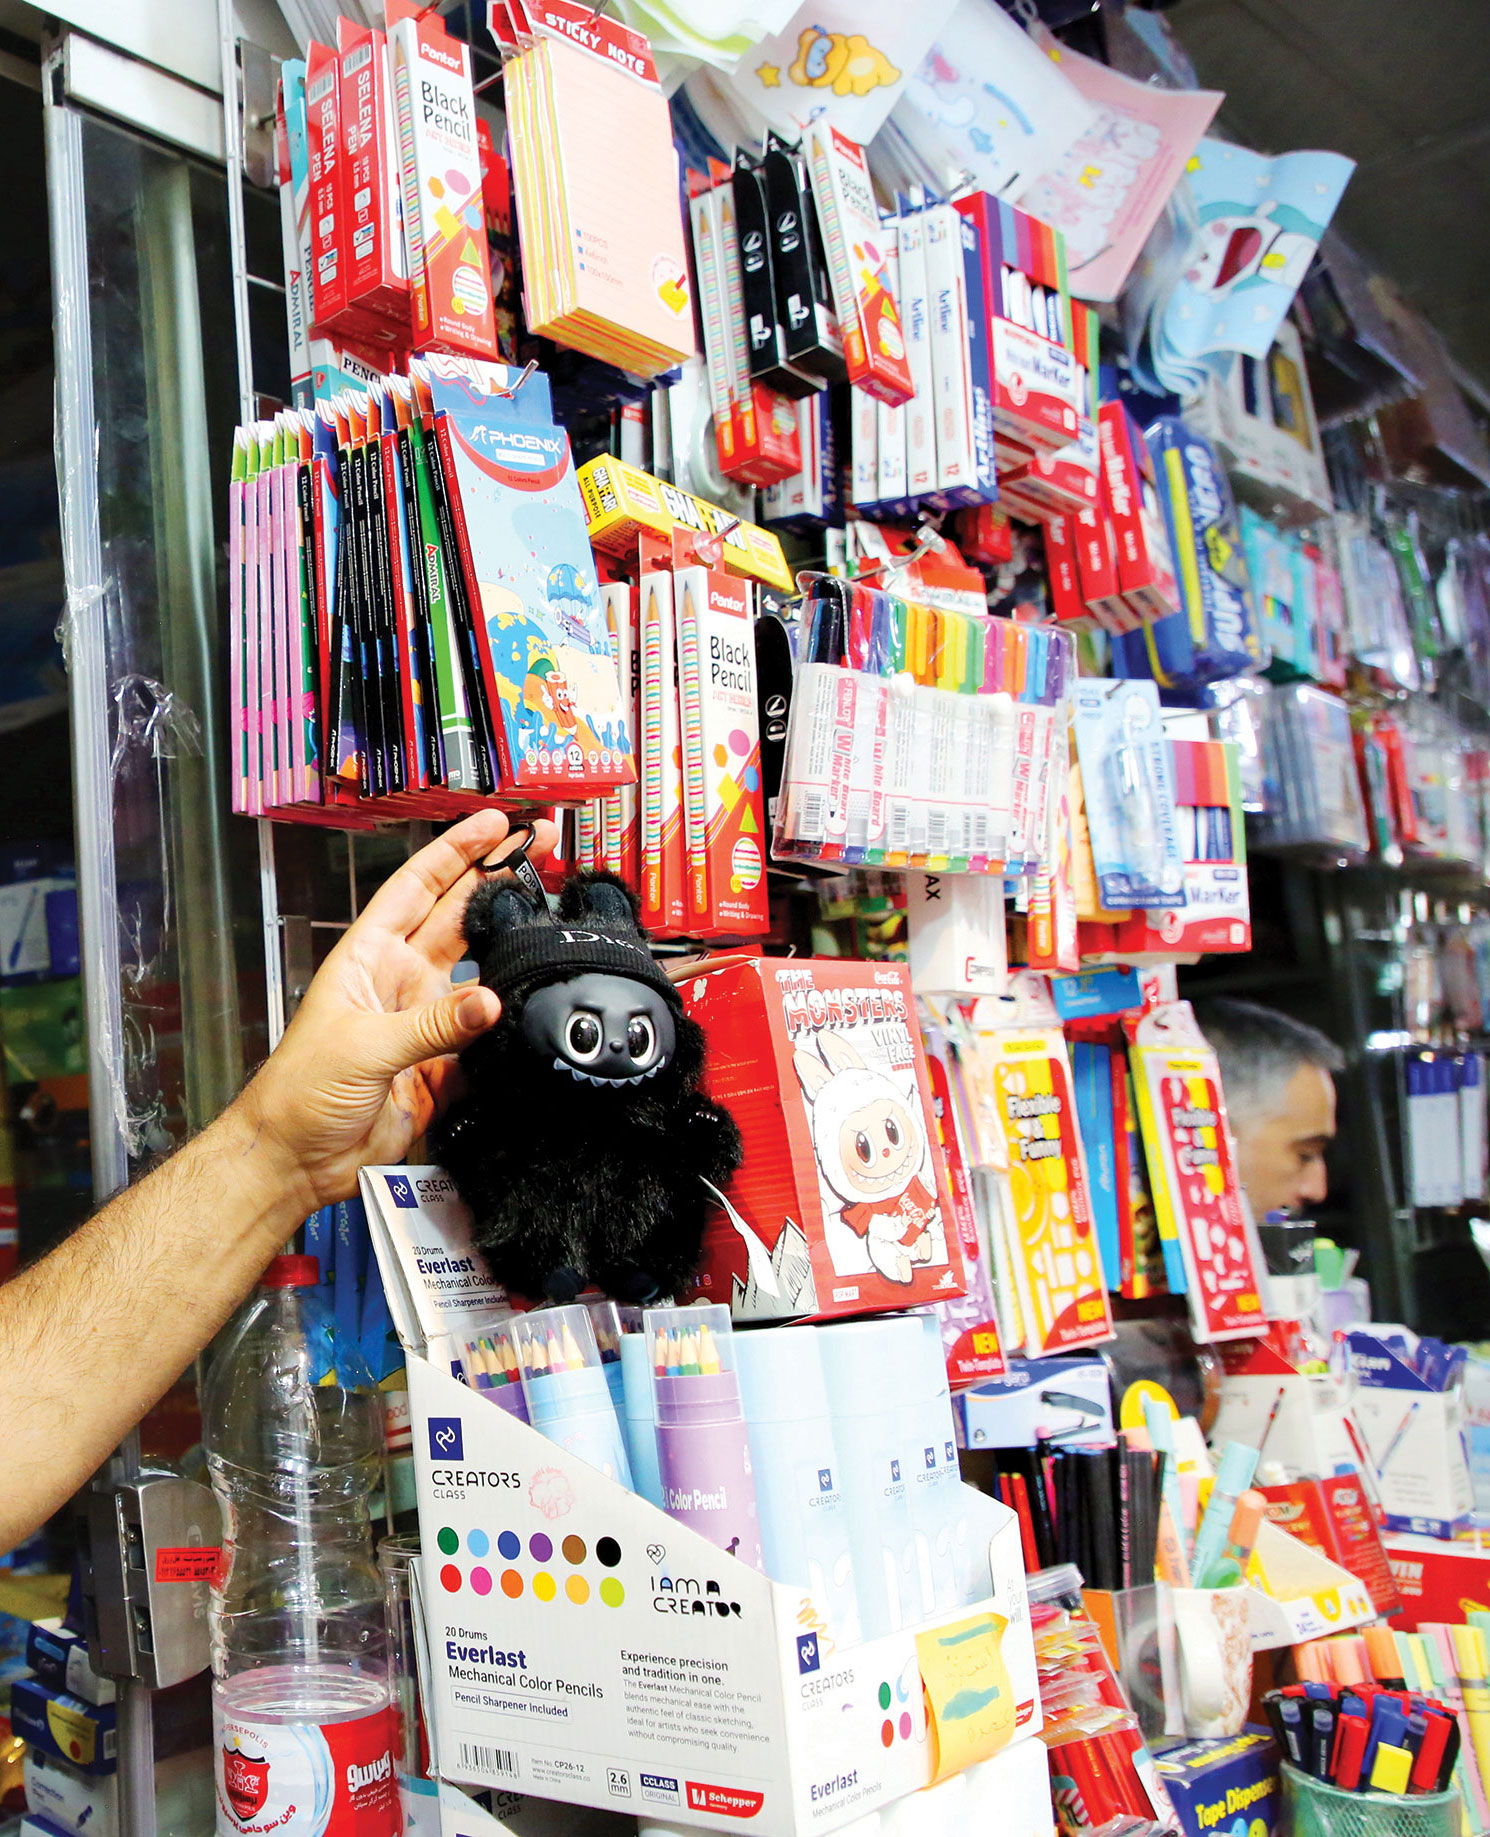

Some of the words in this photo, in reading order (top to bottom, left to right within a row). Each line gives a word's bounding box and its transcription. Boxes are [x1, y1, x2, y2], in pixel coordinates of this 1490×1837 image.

[545, 12, 601, 49] STICKY
[608, 42, 645, 75] NOTE
[420, 42, 461, 70] Panter
[357, 69, 372, 148] SELENA
[421, 80, 469, 120] Black
[423, 104, 471, 142] Pencil
[321, 98, 336, 174] SELENA
[347, 127, 357, 156] PEN
[311, 153, 321, 182] PEN
[289, 270, 302, 352] ADMIRAL
[401, 440, 407, 450] 12
[428, 442, 433, 451] 12
[488, 430, 561, 454] PHOENIX
[973, 386, 990, 488] Artline
[340, 462, 346, 471] 12
[355, 458, 361, 468] 12
[370, 452, 377, 462] 12
[302, 476, 307, 484] 12
[586, 488, 602, 519] PURPOSE
[425, 543, 442, 604] ADMIRAL
[710, 592, 744, 613] Panter
[710, 635, 750, 669] Black
[711, 663, 752, 693] Pencil
[570, 750, 580, 761] 12
[830, 753, 842, 800] Marker
[871, 789, 883, 827] Board
[518, 865, 537, 889] POP
[723, 901, 737, 910] Round
[738, 902, 750, 911] Body
[723, 910, 740, 919] Writing
[745, 913, 764, 921] Drawing
[775, 969, 815, 993] THE
[783, 988, 909, 1041] MONSTERS
[871, 1027, 912, 1047] VINYL
[888, 1045, 915, 1064] FACE
[421, 1194, 445, 1203] CLASS
[412, 1247, 421, 1255] 20
[421, 1246, 445, 1255] Drums
[416, 1257, 476, 1275] Everlast
[423, 1277, 472, 1290] Mechanical
[472, 1275, 497, 1287] Colo
[434, 1299, 453, 1309] Pencil
[453, 1297, 484, 1309] Sharpener
[431, 1469, 521, 1489] CREATORS
[433, 1489, 466, 1500] CLASS
[669, 1487, 692, 1511] Color
[693, 1486, 728, 1511] Pencil
[651, 1576, 655, 1591] I
[660, 1577, 700, 1595] AM
[706, 1580, 721, 1596] A
[653, 1596, 742, 1619] CREATOR
[445, 1626, 457, 1637] 20
[458, 1628, 488, 1640] Drums
[446, 1641, 527, 1669] Everlast
[620, 1650, 677, 1666] Experience
[679, 1658, 729, 1671] precision
[449, 1665, 516, 1687] Mechanical
[519, 1675, 552, 1692] Color
[556, 1679, 604, 1698] Pencils
[622, 1666, 641, 1676] and
[643, 1667, 686, 1682] tradition
[689, 1672, 699, 1683] in
[701, 1675, 725, 1686] one.
[800, 1669, 855, 1699] CREATORS
[624, 1679, 637, 1688] The
[638, 1681, 668, 1692] Everlast
[669, 1684, 712, 1697] Mechanical
[714, 1690, 735, 1700] Color
[737, 1693, 761, 1702] Pencil
[455, 1692, 481, 1705] Pencil
[483, 1695, 527, 1712] Sharpener
[529, 1702, 568, 1717] Included
[624, 1691, 648, 1701] blends
[650, 1694, 692, 1707] mechanical
[694, 1701, 712, 1710] ease
[713, 1703, 730, 1711] with
[731, 1704, 745, 1713] the
[625, 1705, 659, 1716] authentic
[660, 1708, 674, 1718] feel
[676, 1711, 684, 1719] of
[685, 1712, 712, 1723] classic
[222, 1723, 269, 1749] PERSEPOLIS
[626, 1716, 644, 1726] ideal
[645, 1719, 656, 1728] for
[658, 1721, 681, 1731] artists
[683, 1726, 699, 1734] who
[700, 1727, 718, 1736] seek
[719, 1730, 770, 1743] convenience
[628, 1729, 655, 1739] without
[656, 1733, 710, 1749] compromising
[554, 1760, 585, 1773] CP26-12
[610, 1772, 627, 1785] 2.6
[611, 1784, 629, 1794] mm
[642, 1776, 676, 1790] CCLASS
[810, 1768, 859, 1801] Everlast
[645, 1790, 676, 1802] ORIGINAL
[708, 1792, 757, 1808] Schepper
[1195, 1798, 1227, 1830] Tape
